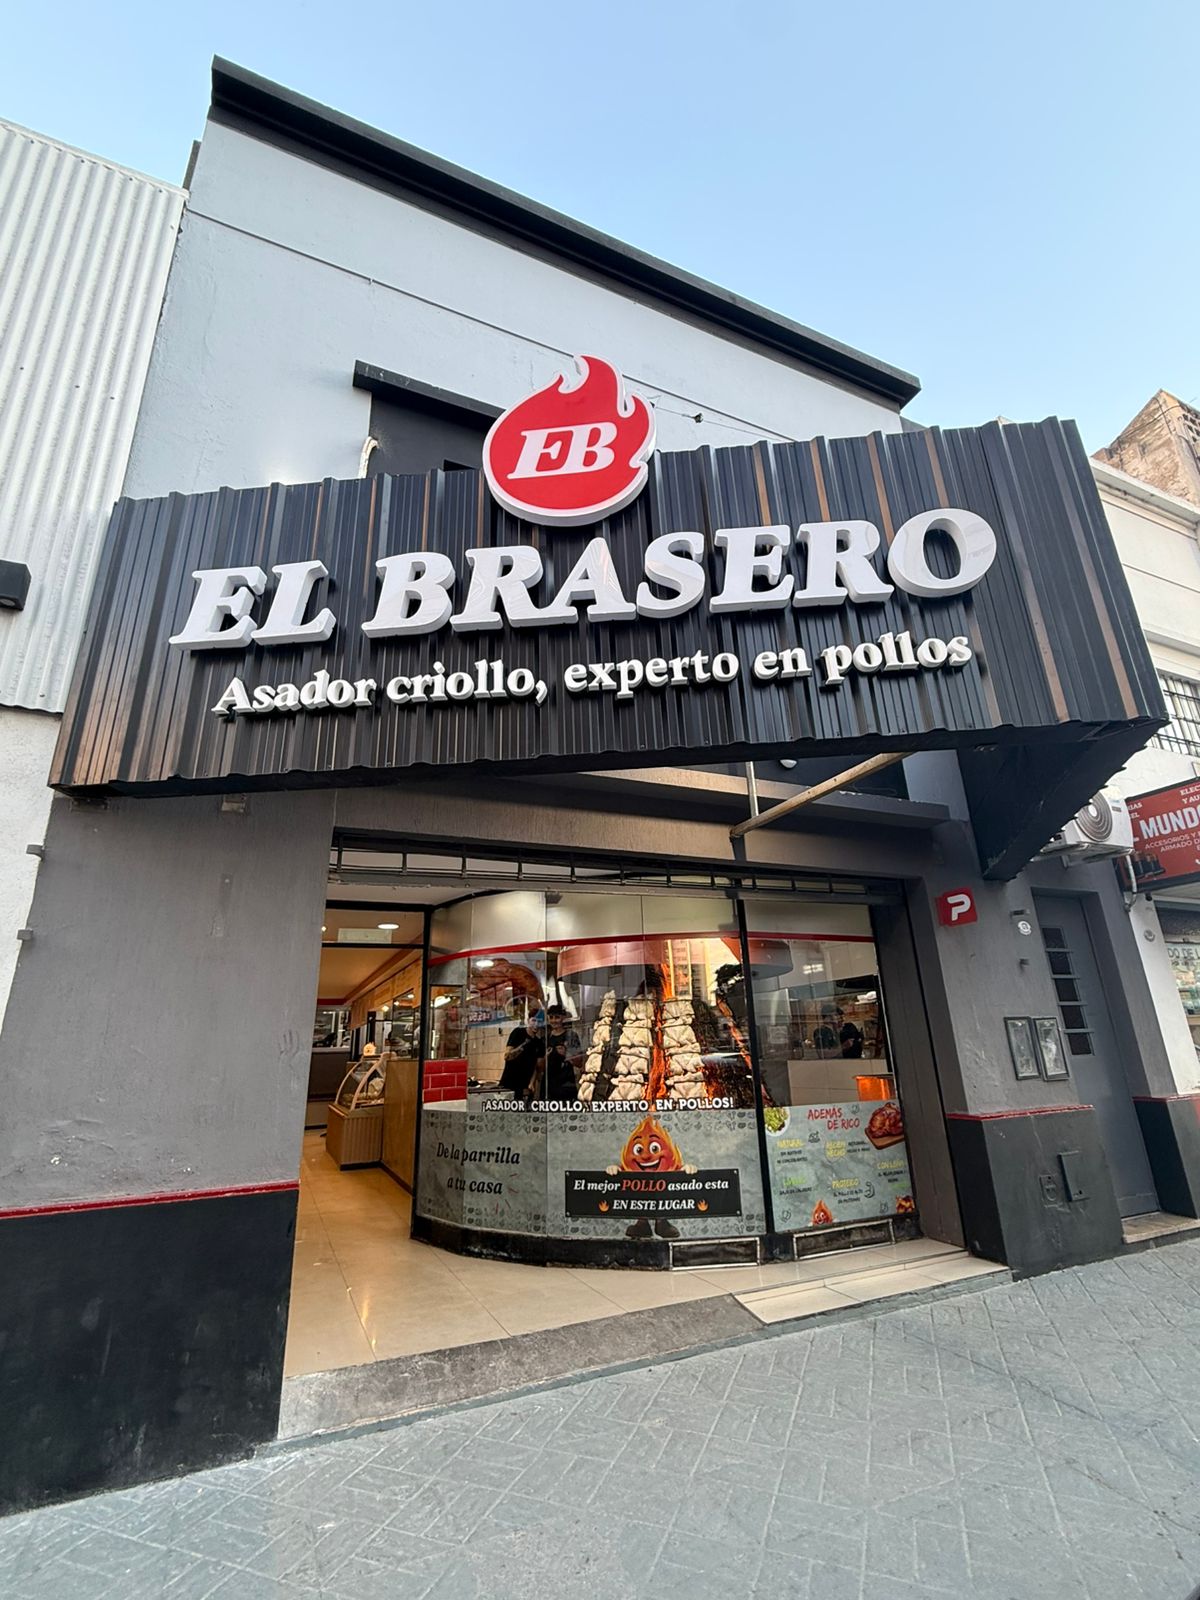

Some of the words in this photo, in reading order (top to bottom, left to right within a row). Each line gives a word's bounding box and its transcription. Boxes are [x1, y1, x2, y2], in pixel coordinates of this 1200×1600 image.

[507, 422, 618, 479] EB
[168, 560, 337, 651] EL
[361, 507, 998, 639] BRASERO
[211, 669, 376, 718] Asador
[386, 659, 548, 706] criollo,
[564, 648, 740, 699] experto
[754, 645, 812, 680] en
[820, 630, 973, 686] pollos
[482, 1099, 526, 1112] ¡ASADOR
[531, 1099, 588, 1113] CRIOLLO,
[592, 1098, 649, 1112] EXPERTO
[656, 1098, 674, 1111] EN
[679, 1096, 735, 1110] POLLOS!
[827, 1120, 839, 1130] DE
[841, 1118, 861, 1129] RICO
[437, 1142, 449, 1158] De
[450, 1144, 460, 1160] la
[460, 1147, 521, 1166] parrilla
[447, 1177, 454, 1188] a
[455, 1178, 466, 1191] tu
[469, 1180, 503, 1194] casa
[574, 1180, 585, 1190] El
[587, 1181, 621, 1193] mejor
[621, 1179, 667, 1192] POLLO
[667, 1179, 703, 1190] asado
[704, 1179, 729, 1190] esta
[613, 1200, 629, 1210] EN
[630, 1199, 657, 1210] ESTE
[658, 1199, 695, 1210] LUGAR
